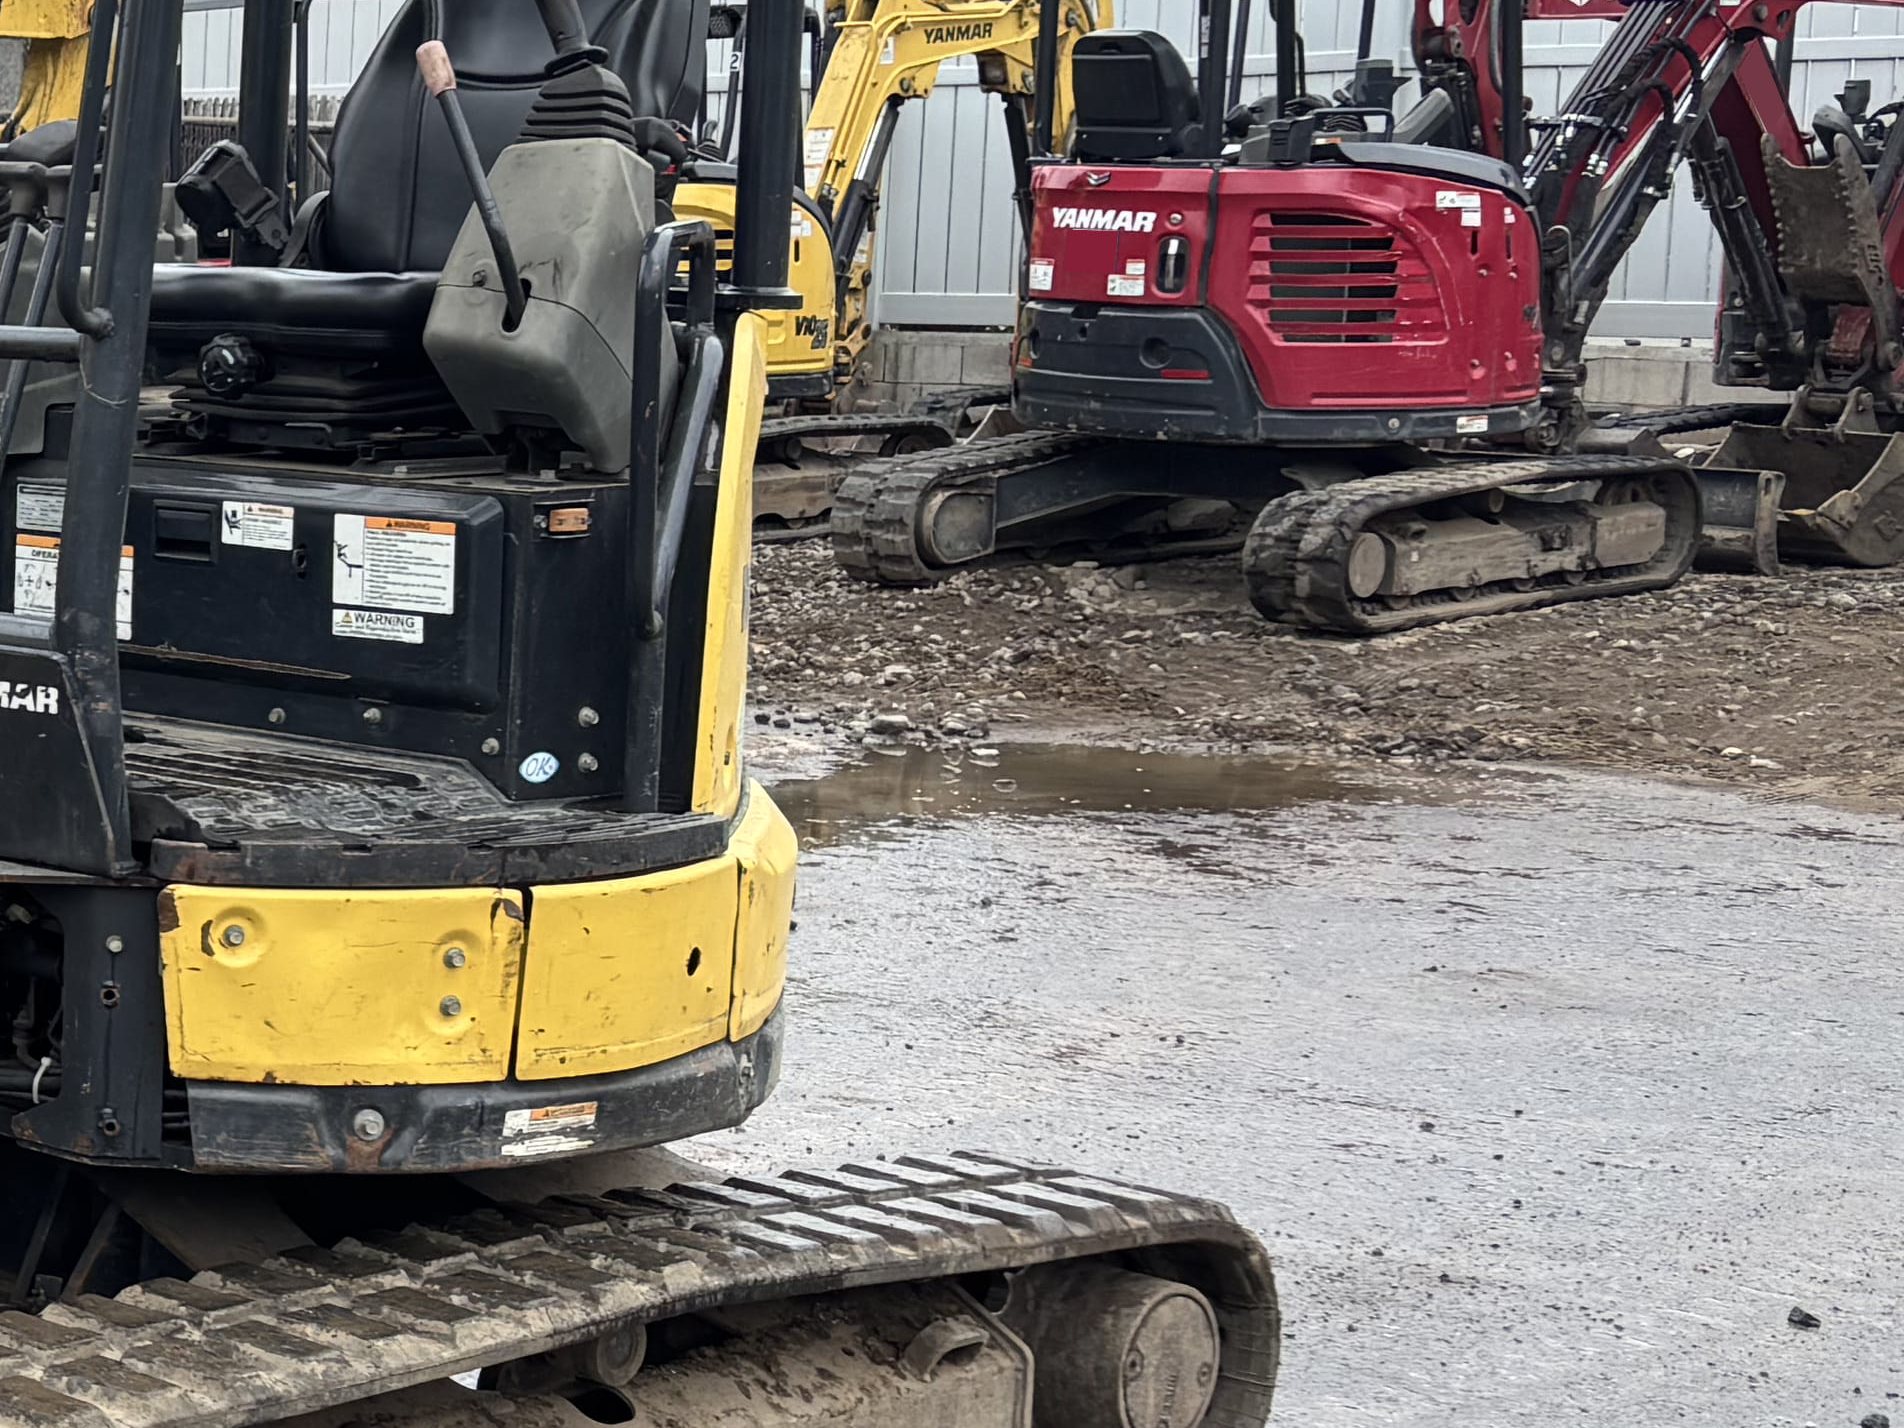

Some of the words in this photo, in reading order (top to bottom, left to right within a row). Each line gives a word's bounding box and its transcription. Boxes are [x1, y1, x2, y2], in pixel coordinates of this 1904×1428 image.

[924, 22, 993, 44] YANMAR
[1052, 206, 1157, 233] YANMAR
[394, 521, 431, 531] WARNING
[353, 612, 416, 629] WARNING
[526, 757, 552, 777] OK
